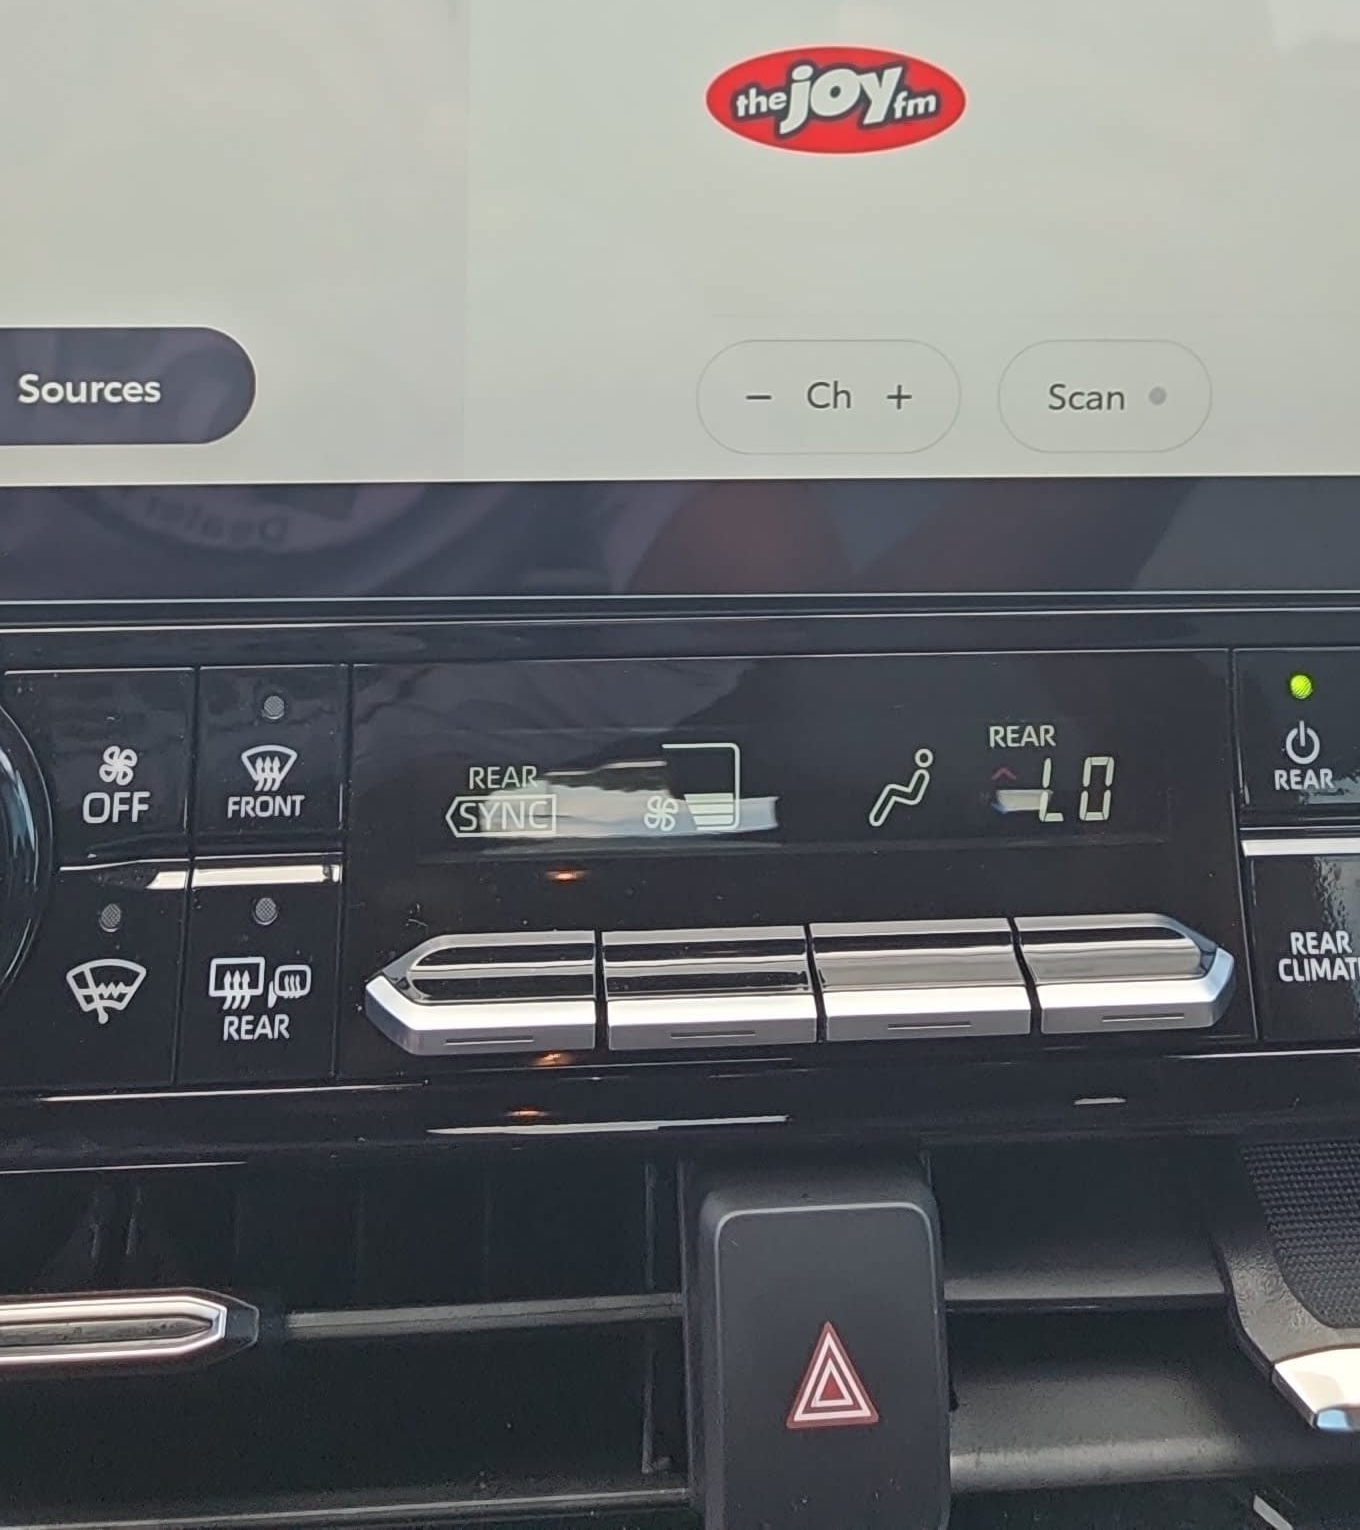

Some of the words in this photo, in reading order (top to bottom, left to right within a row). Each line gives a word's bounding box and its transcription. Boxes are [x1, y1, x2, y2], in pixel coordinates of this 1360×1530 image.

[17, 372, 161, 407] Sources
[806, 380, 851, 410] Ch
[1048, 384, 1126, 411] Scan
[989, 725, 1056, 747] REAR
[468, 767, 539, 790] REAR
[1040, 756, 1115, 822] LO
[1274, 768, 1335, 791] REAR
[83, 791, 151, 824] OFF
[227, 795, 306, 818] FRONT
[457, 801, 548, 832] SYNC
[1289, 931, 1353, 955] REAR
[223, 1015, 290, 1041] REAR
